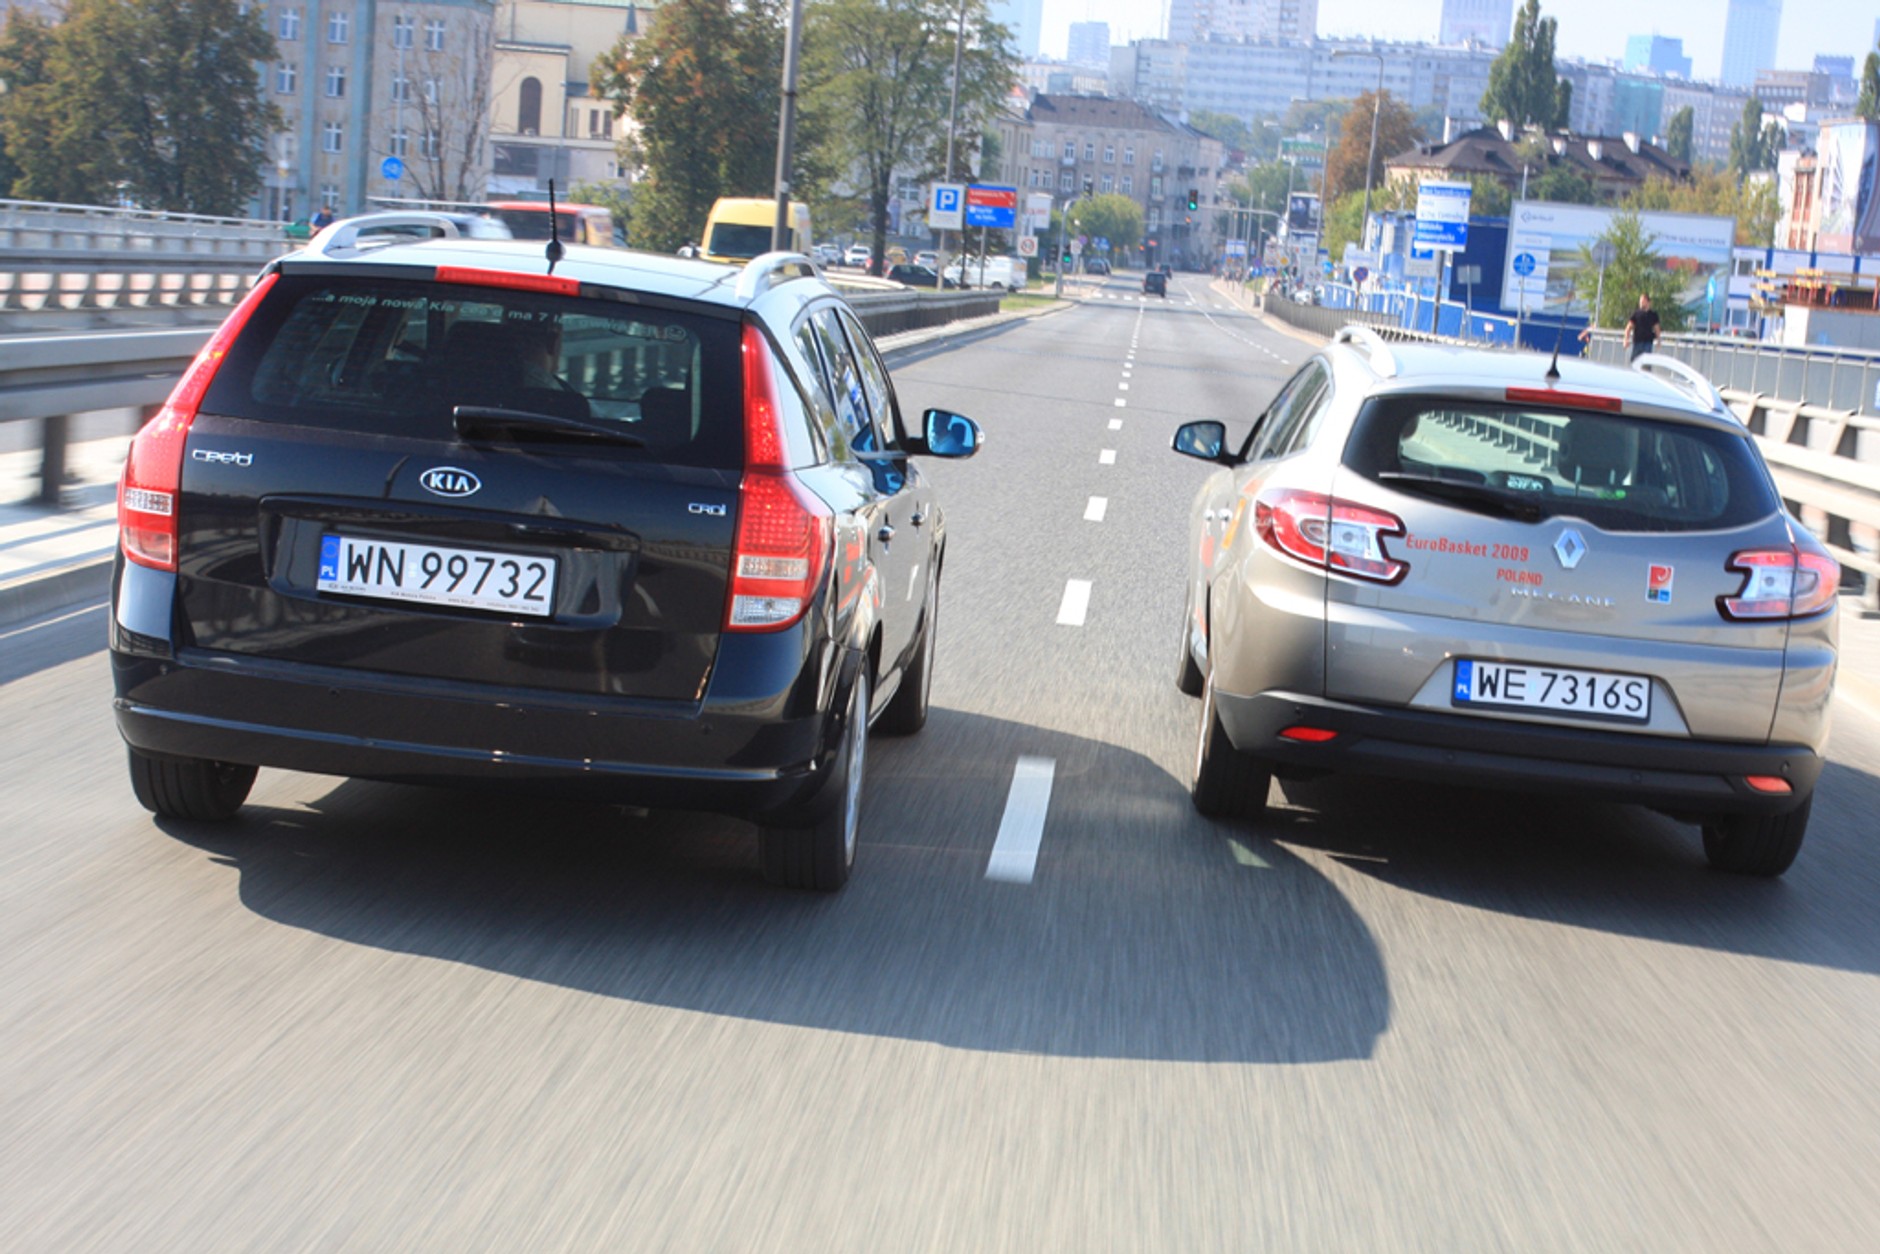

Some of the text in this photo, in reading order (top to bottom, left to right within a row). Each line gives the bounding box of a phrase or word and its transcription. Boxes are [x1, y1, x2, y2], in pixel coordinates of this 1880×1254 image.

[939, 190, 955, 209] P
[339, 295, 378, 307] moja
[429, 300, 455, 313] Kia
[508, 310, 533, 320] ma
[538, 312, 548, 322] 7
[429, 471, 471, 491] KIA
[1406, 533, 1530, 562] EuroBasket 2009
[321, 543, 547, 602] PL WN 99732
[1496, 567, 1544, 586] POLAND
[1457, 665, 1644, 712] PL WE 7316S
